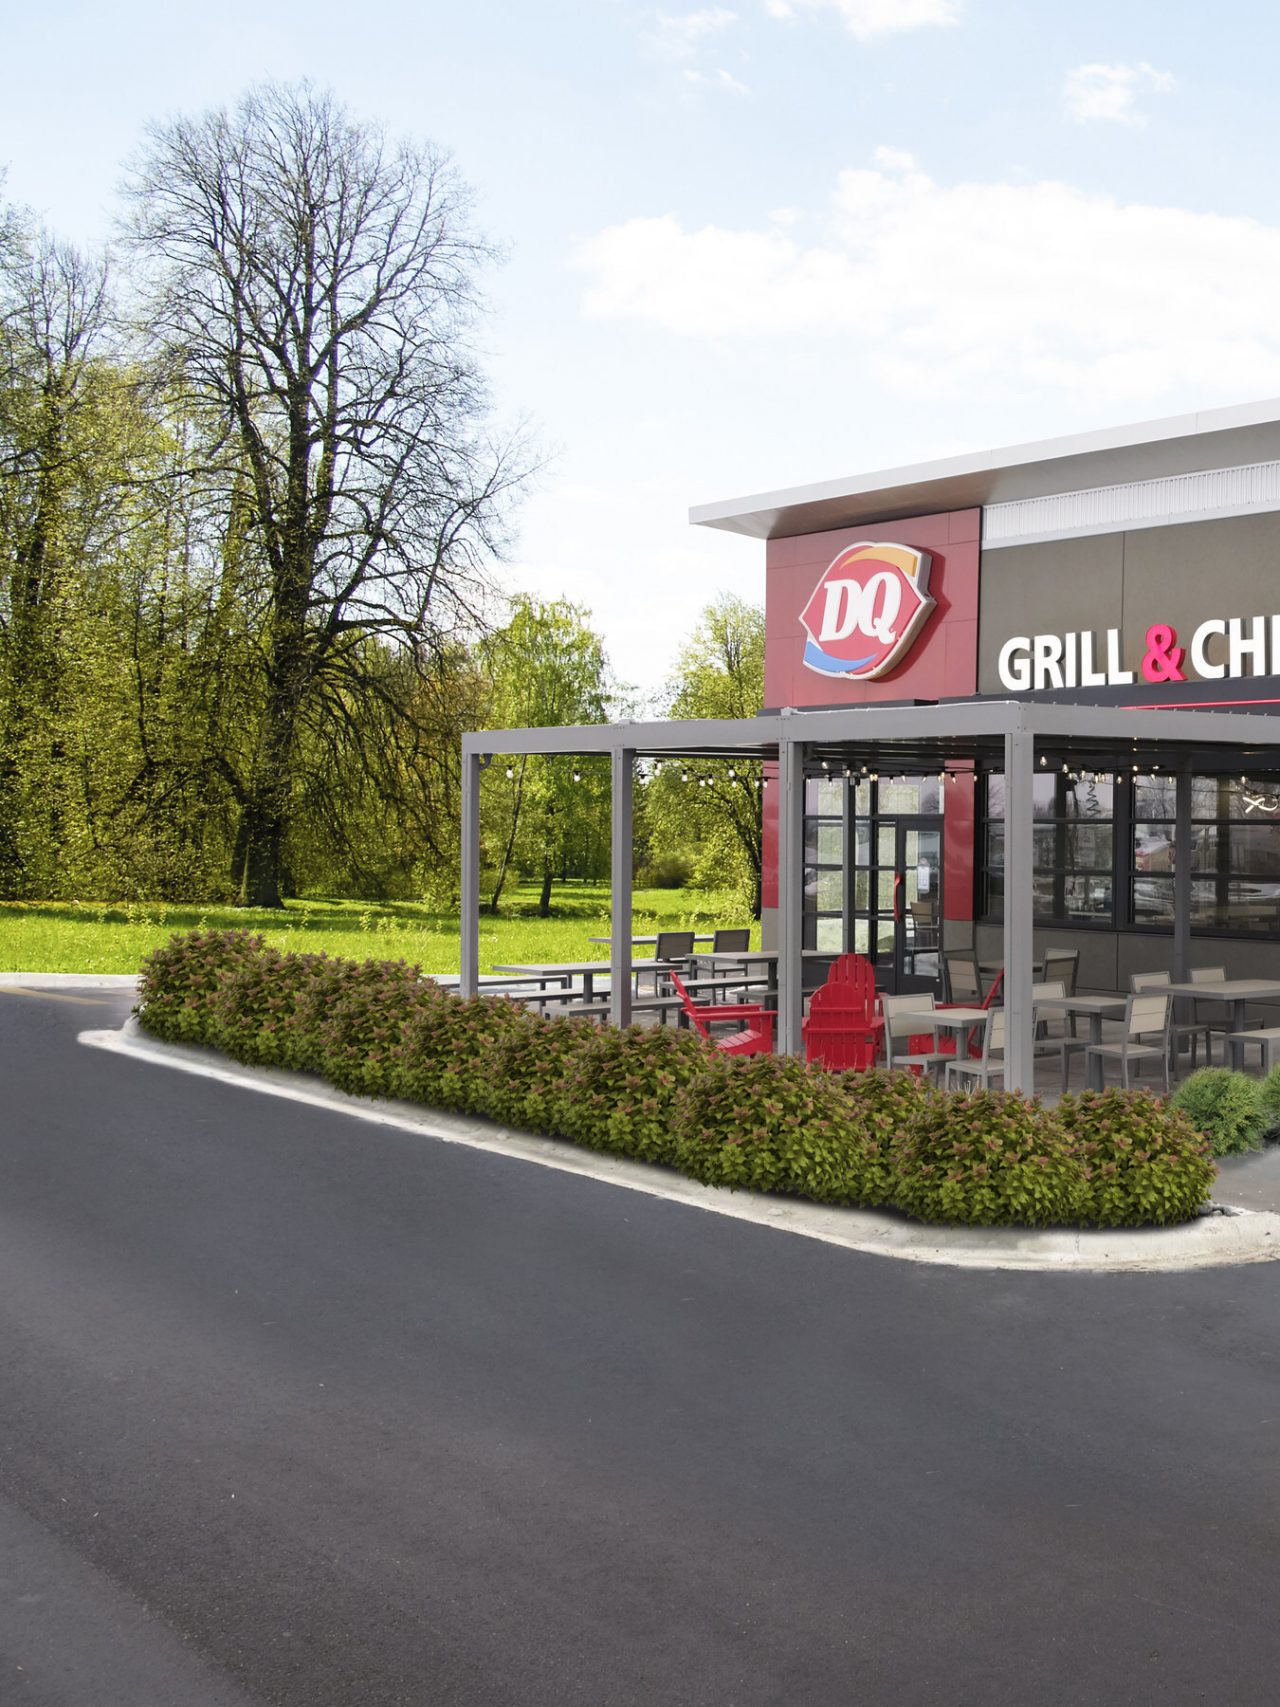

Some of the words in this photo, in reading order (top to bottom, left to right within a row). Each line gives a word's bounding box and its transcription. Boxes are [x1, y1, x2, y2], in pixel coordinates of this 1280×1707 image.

[819, 571, 900, 643] DQ
[998, 629, 1134, 691] GRILL
[1142, 624, 1186, 683] &
